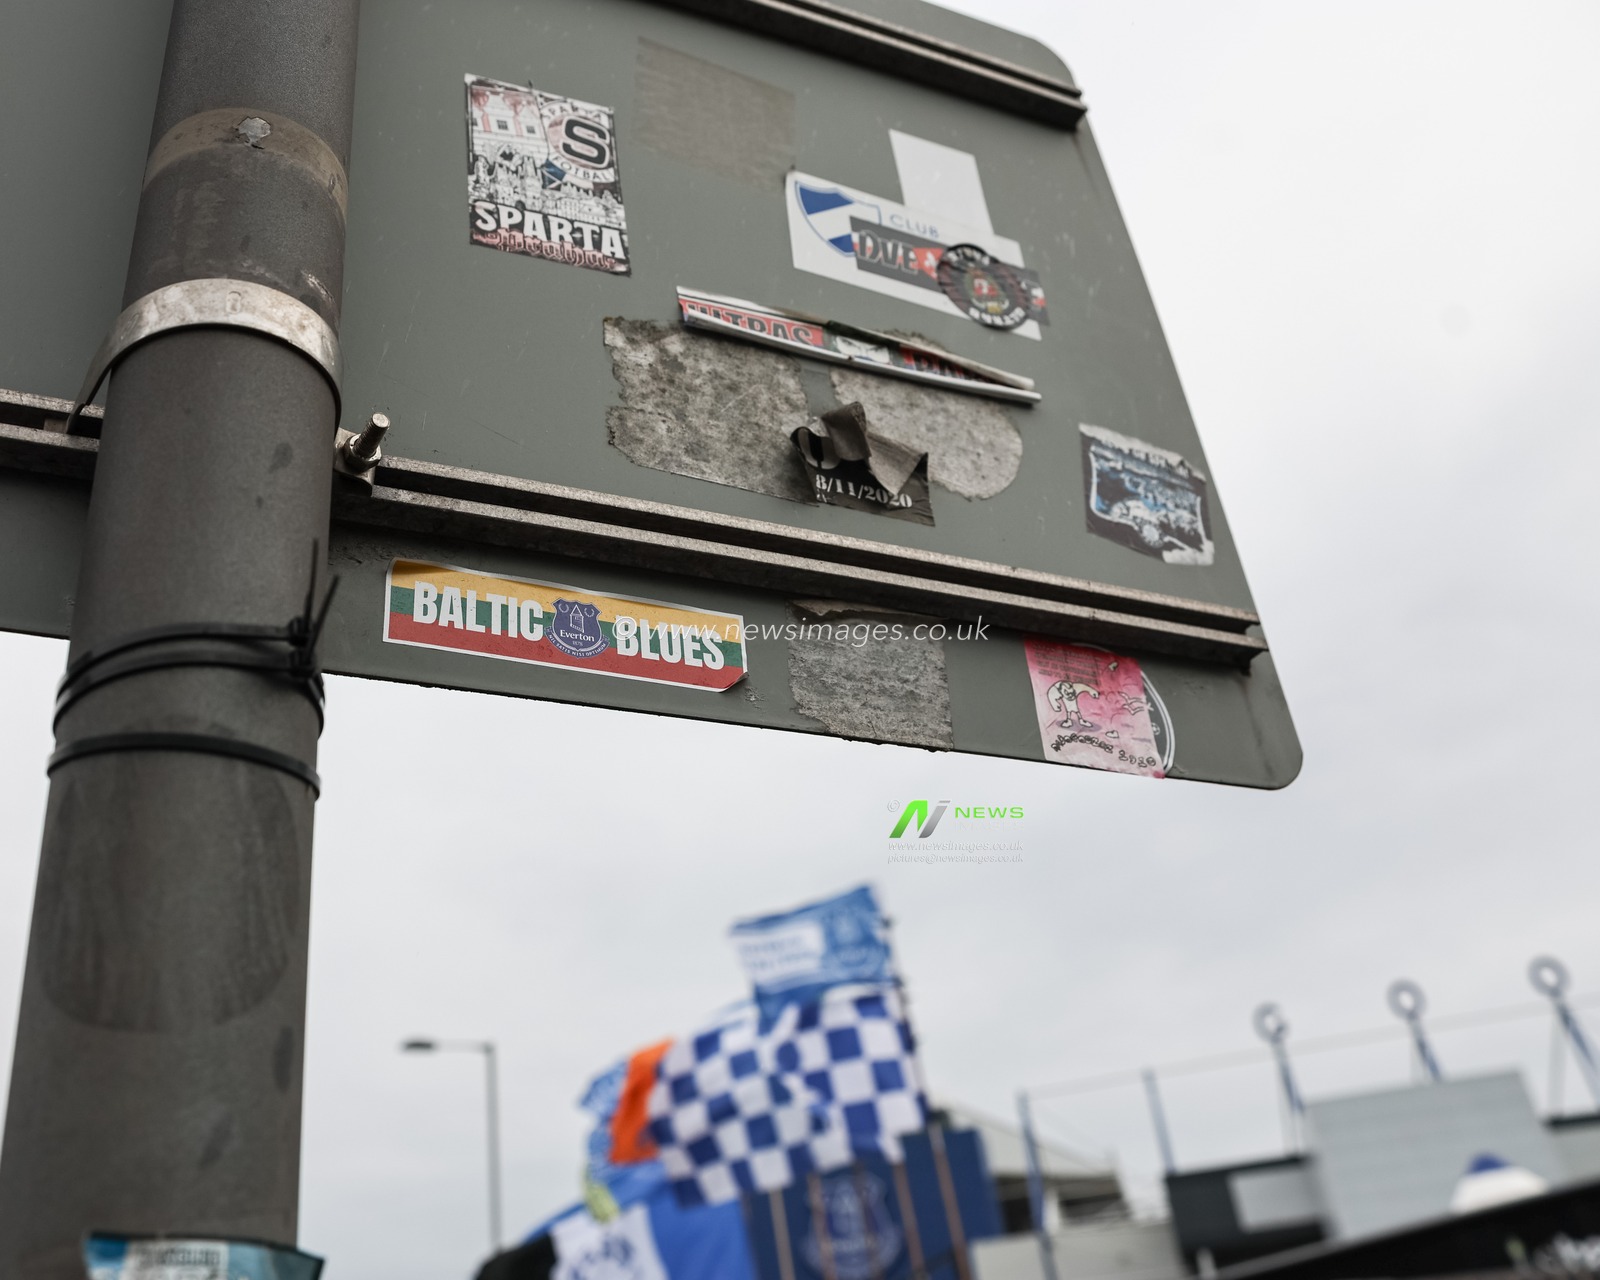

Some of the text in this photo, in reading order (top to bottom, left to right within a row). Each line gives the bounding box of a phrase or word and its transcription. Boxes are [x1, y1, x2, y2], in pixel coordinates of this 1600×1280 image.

[474, 201, 626, 260] SPARTA
[889, 214, 939, 239] CLUB
[815, 474, 913, 508] 8/11/2020
[413, 580, 544, 642] BALTIC
[560, 629, 595, 642] Everton
[615, 615, 726, 670] BLUES
